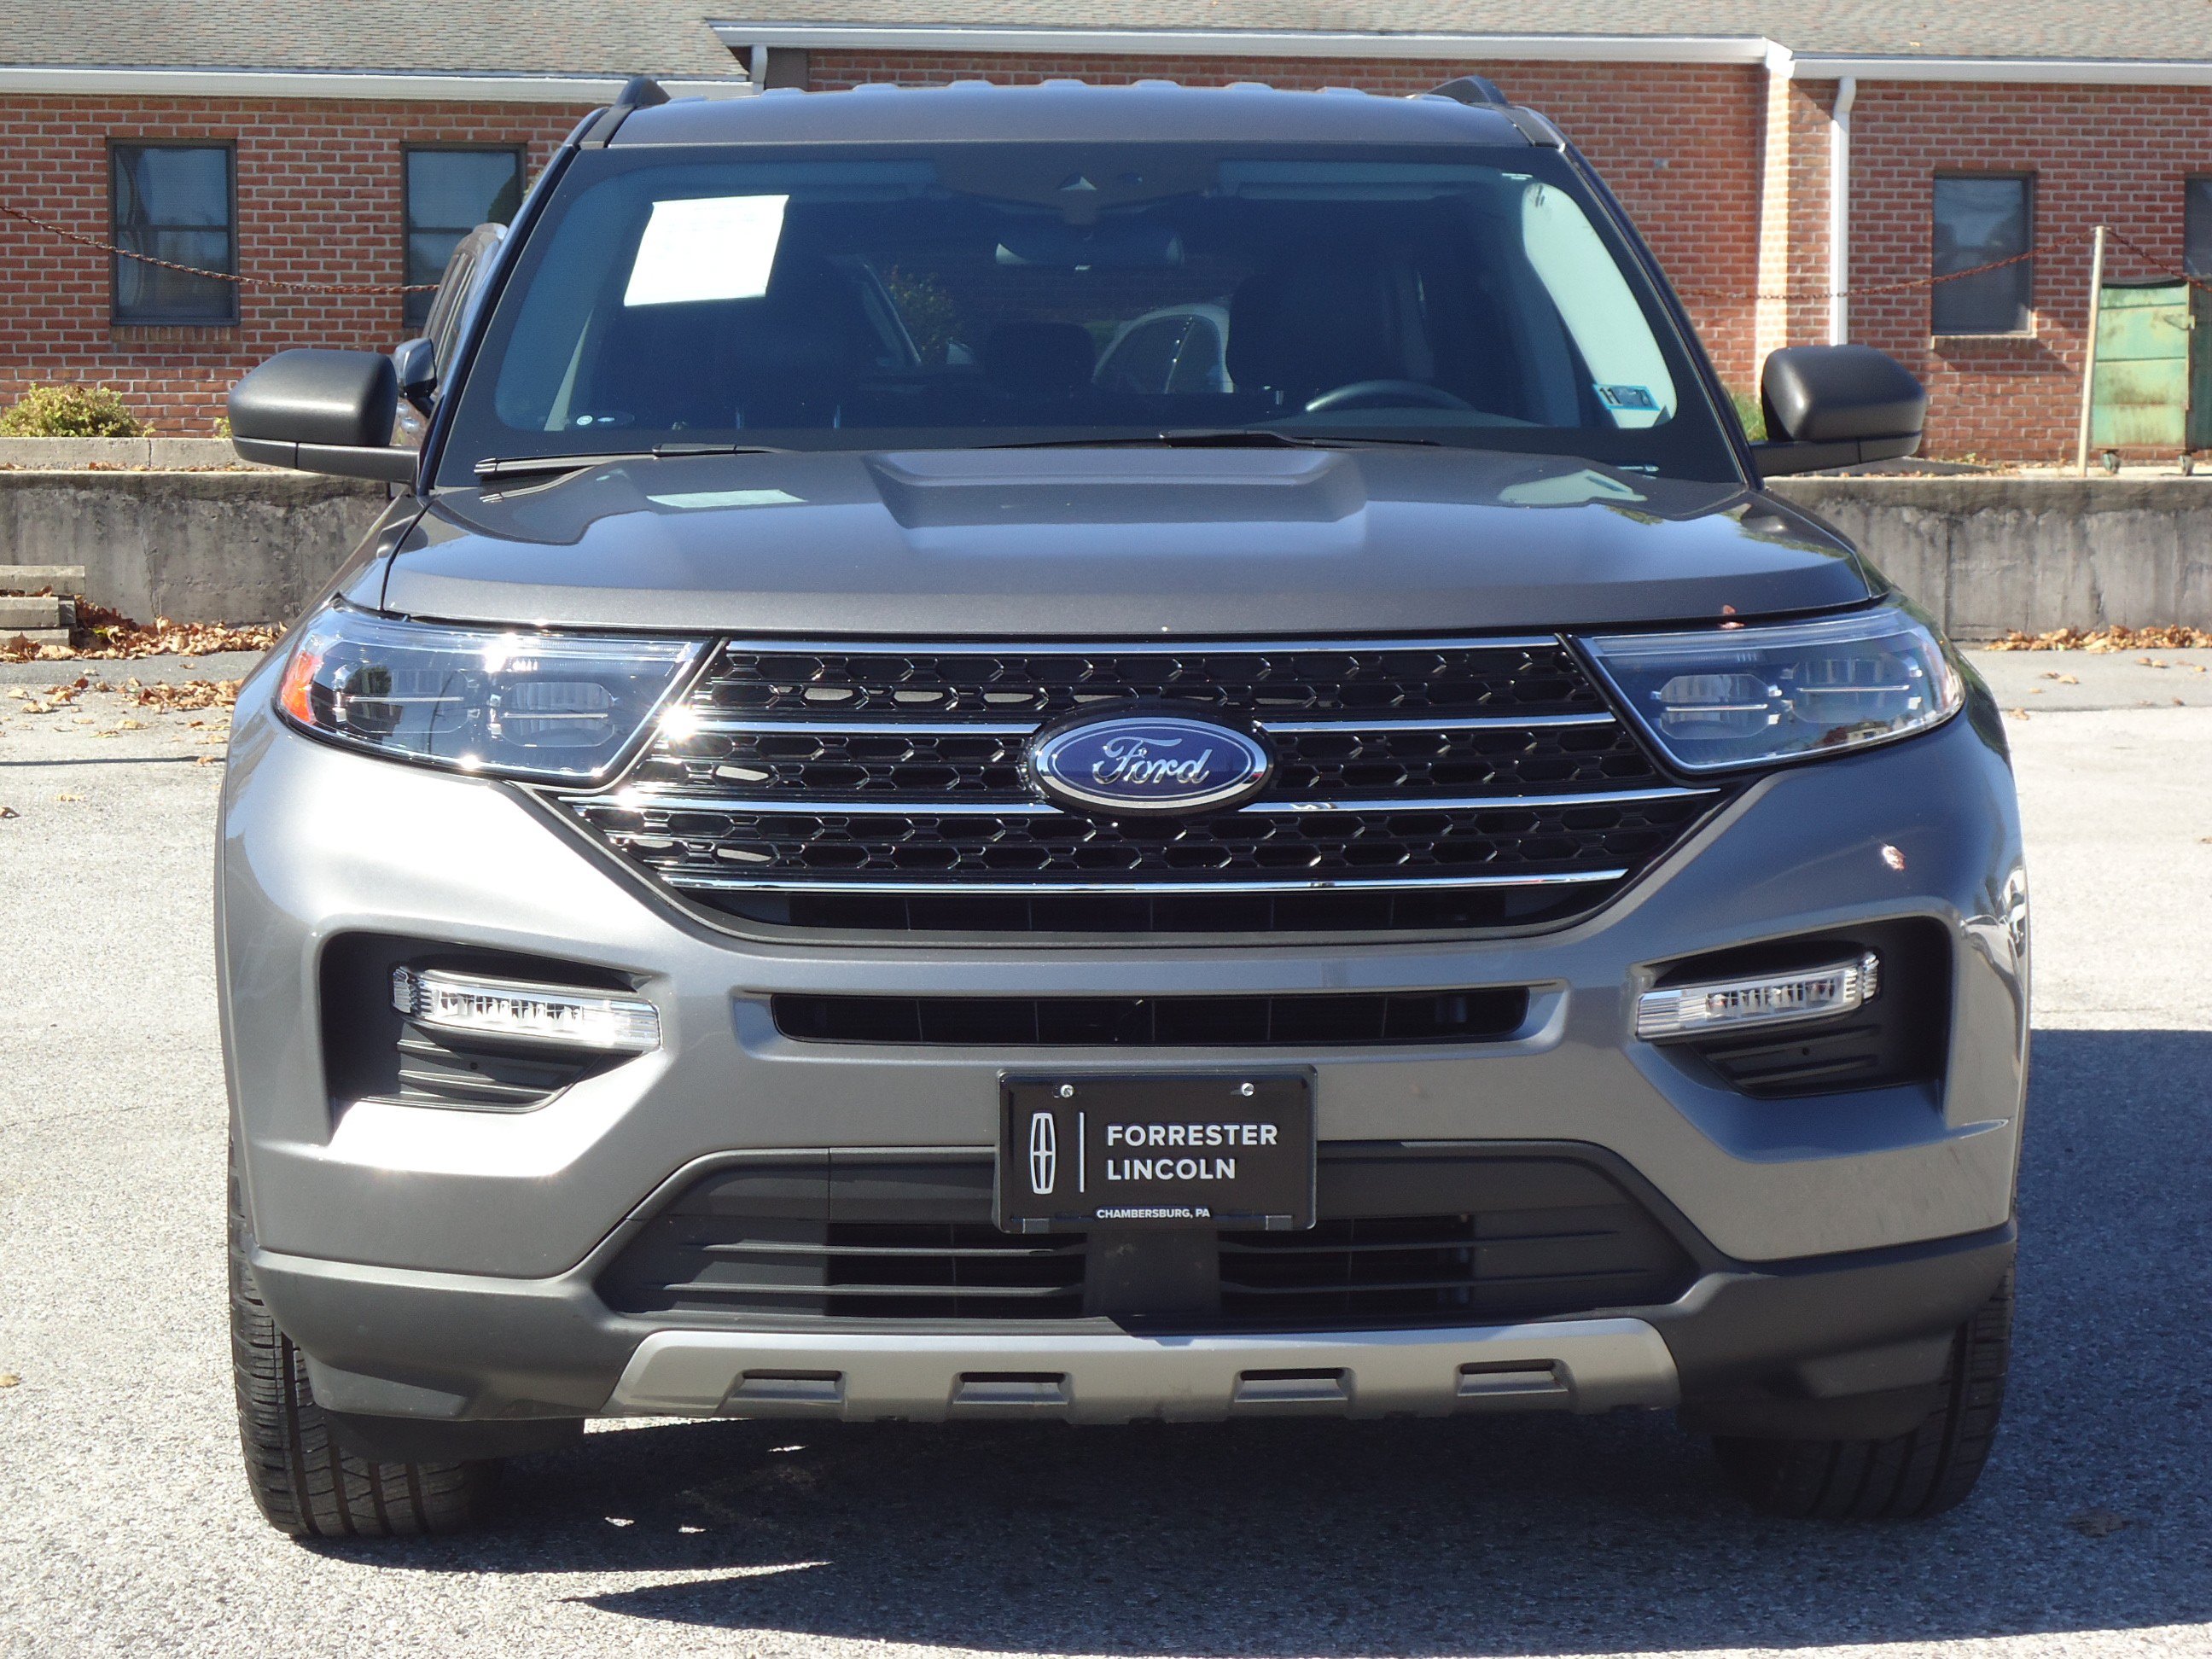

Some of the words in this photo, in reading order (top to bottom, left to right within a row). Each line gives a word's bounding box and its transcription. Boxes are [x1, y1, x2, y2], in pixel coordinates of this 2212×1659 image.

[1091, 736, 1213, 784] Ford
[1107, 1124, 1278, 1147] FORRESTER
[1107, 1158, 1236, 1180] LINCOLN
[1096, 1208, 1193, 1220] CHAMBERSBURG,
[1195, 1208, 1211, 1219] PA
